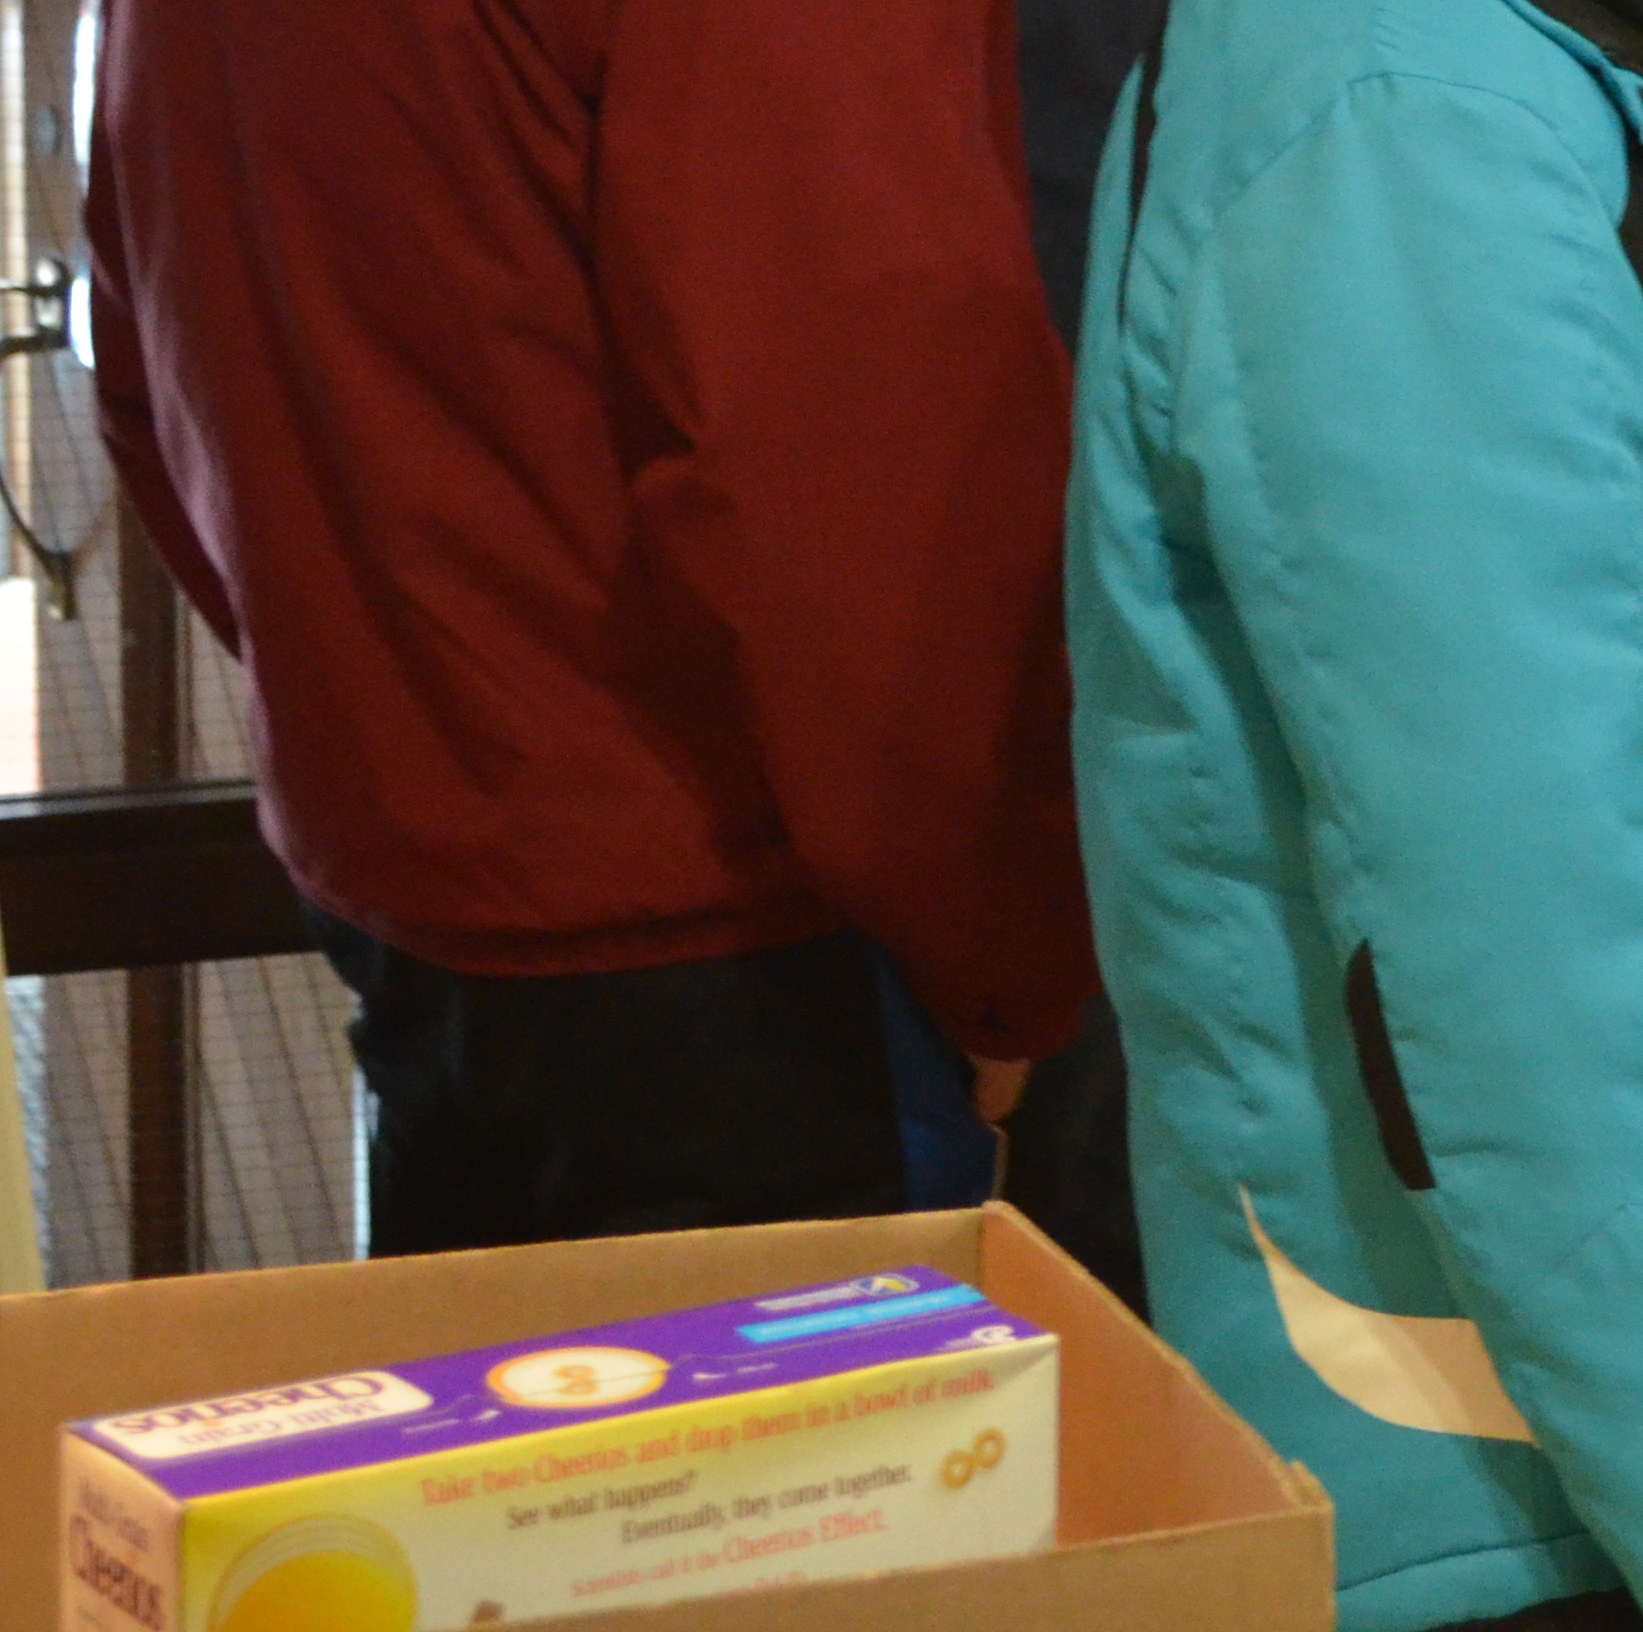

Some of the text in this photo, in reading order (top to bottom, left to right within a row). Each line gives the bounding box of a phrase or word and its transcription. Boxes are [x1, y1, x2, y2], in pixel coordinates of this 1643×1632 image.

[110, 1374, 384, 1436] Cheerios
[532, 1447, 628, 1484] Cheerios
[634, 1431, 681, 1464] and
[684, 1424, 734, 1456] drop
[741, 1410, 802, 1443] them
[505, 1505, 540, 1530] See
[547, 1492, 599, 1520] what
[731, 1494, 772, 1522] they
[777, 1480, 830, 1511] come
[69, 1514, 166, 1632] Cheerios
